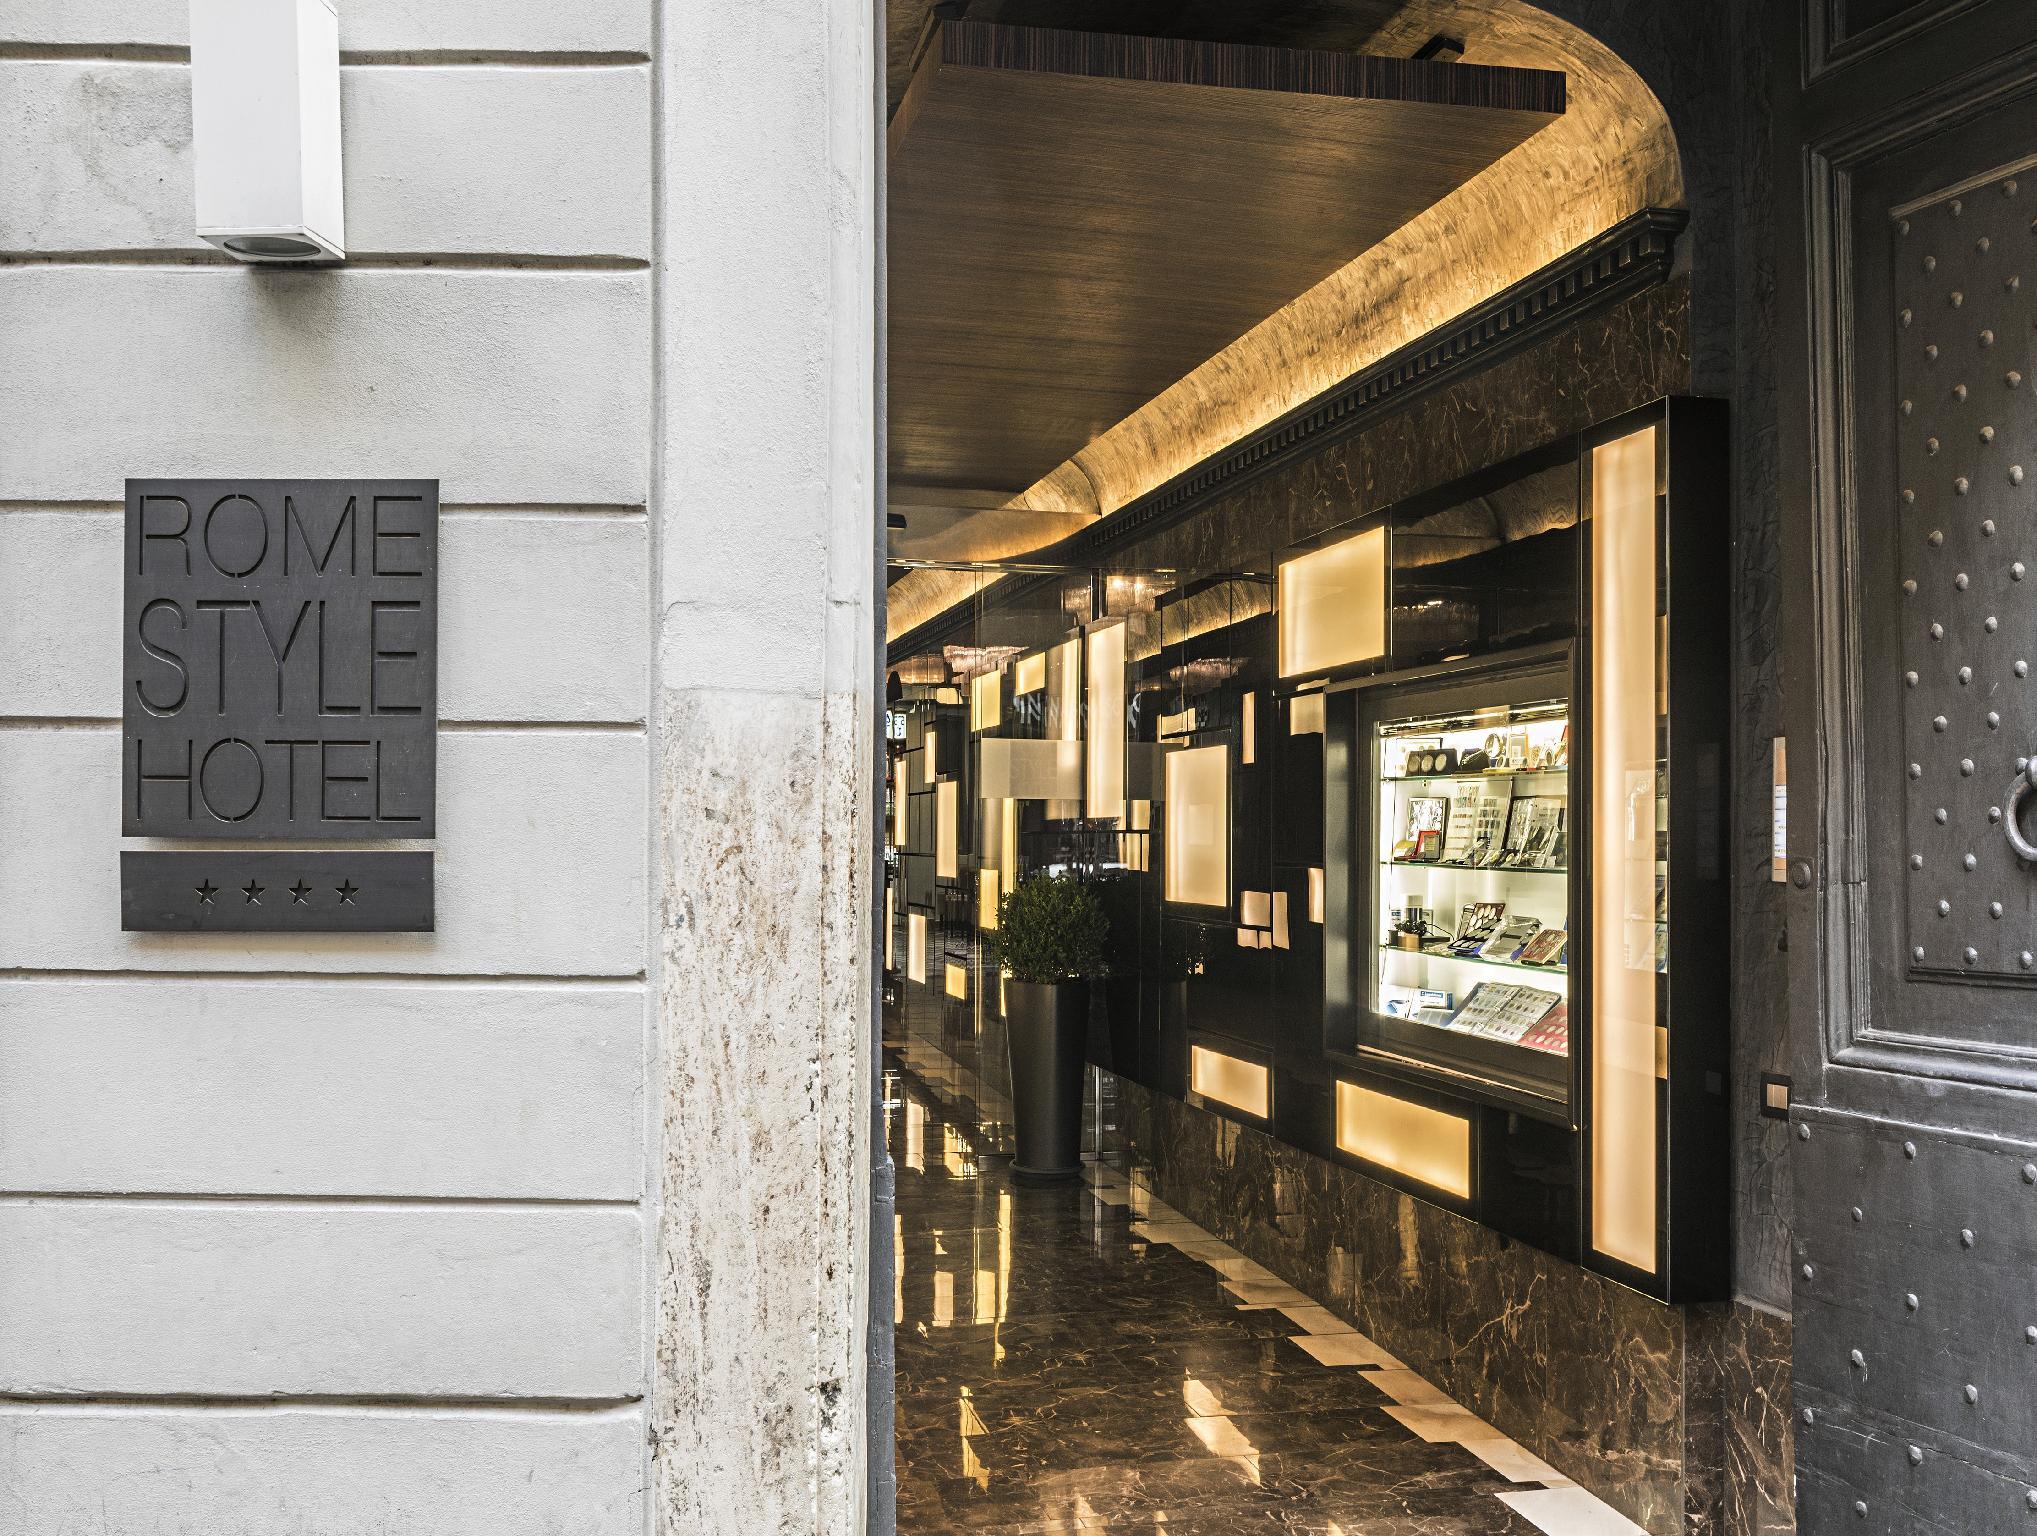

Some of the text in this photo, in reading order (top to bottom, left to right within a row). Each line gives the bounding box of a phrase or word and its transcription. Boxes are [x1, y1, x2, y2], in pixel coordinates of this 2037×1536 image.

[138, 493, 423, 579] ROME
[135, 597, 422, 718] STYLE
[136, 737, 422, 824] HOTEL
